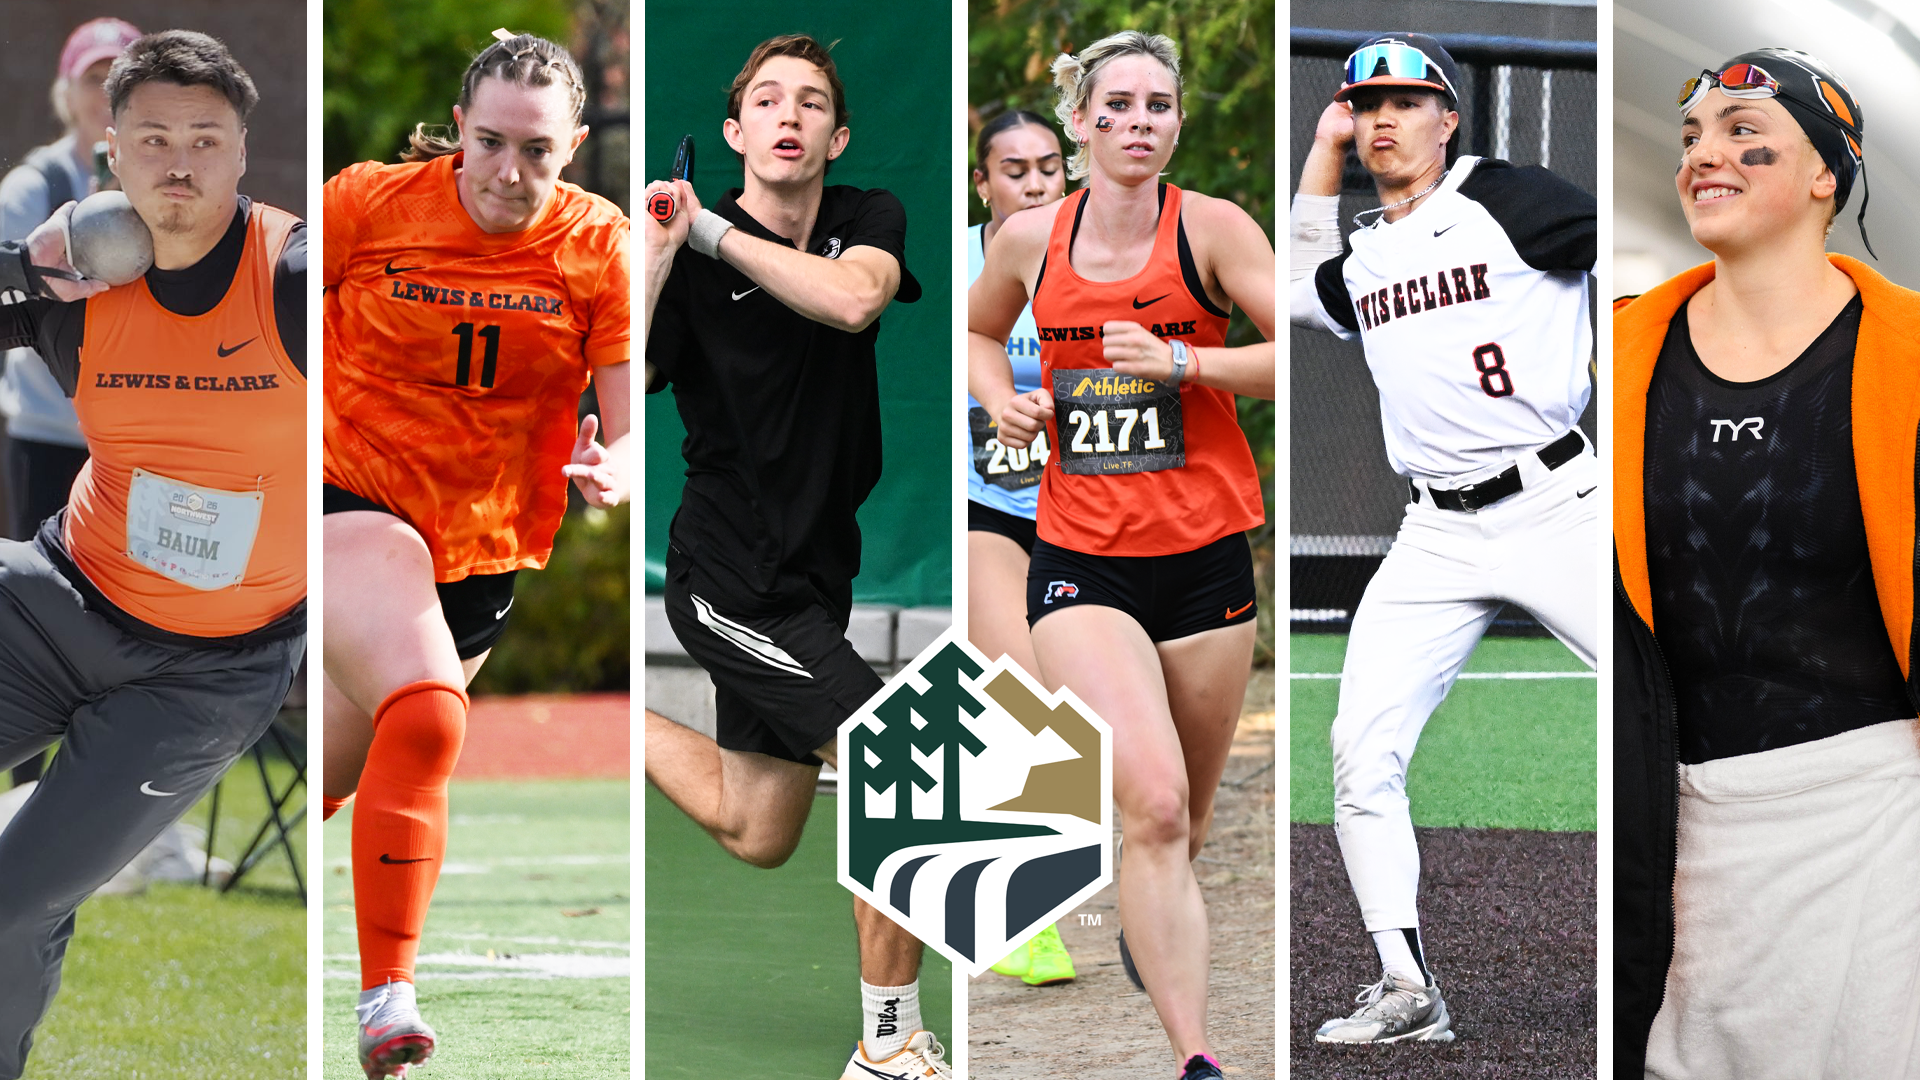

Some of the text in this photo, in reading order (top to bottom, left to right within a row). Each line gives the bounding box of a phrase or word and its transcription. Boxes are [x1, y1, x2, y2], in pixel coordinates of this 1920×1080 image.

[391, 281, 564, 316] LEWIS & CLARK
[1356, 287, 1390, 332] WIS
[1407, 263, 1491, 315] CLARK
[1037, 326, 1095, 342] LEWIS
[1150, 320, 1197, 338] ARK
[452, 322, 501, 388] 11
[1472, 341, 1515, 398] 8
[96, 373, 279, 391] LEWIS & CLARK
[1072, 376, 1155, 397] Athletic
[1068, 407, 1166, 453] 2171
[1710, 417, 1764, 442] TYR
[1103, 461, 1133, 470] Live.TF
[1020, 473, 1043, 485] Live.T
[173, 493, 184, 503] 20
[170, 505, 217, 523] NORTHWEST
[157, 527, 220, 561] BAUM
